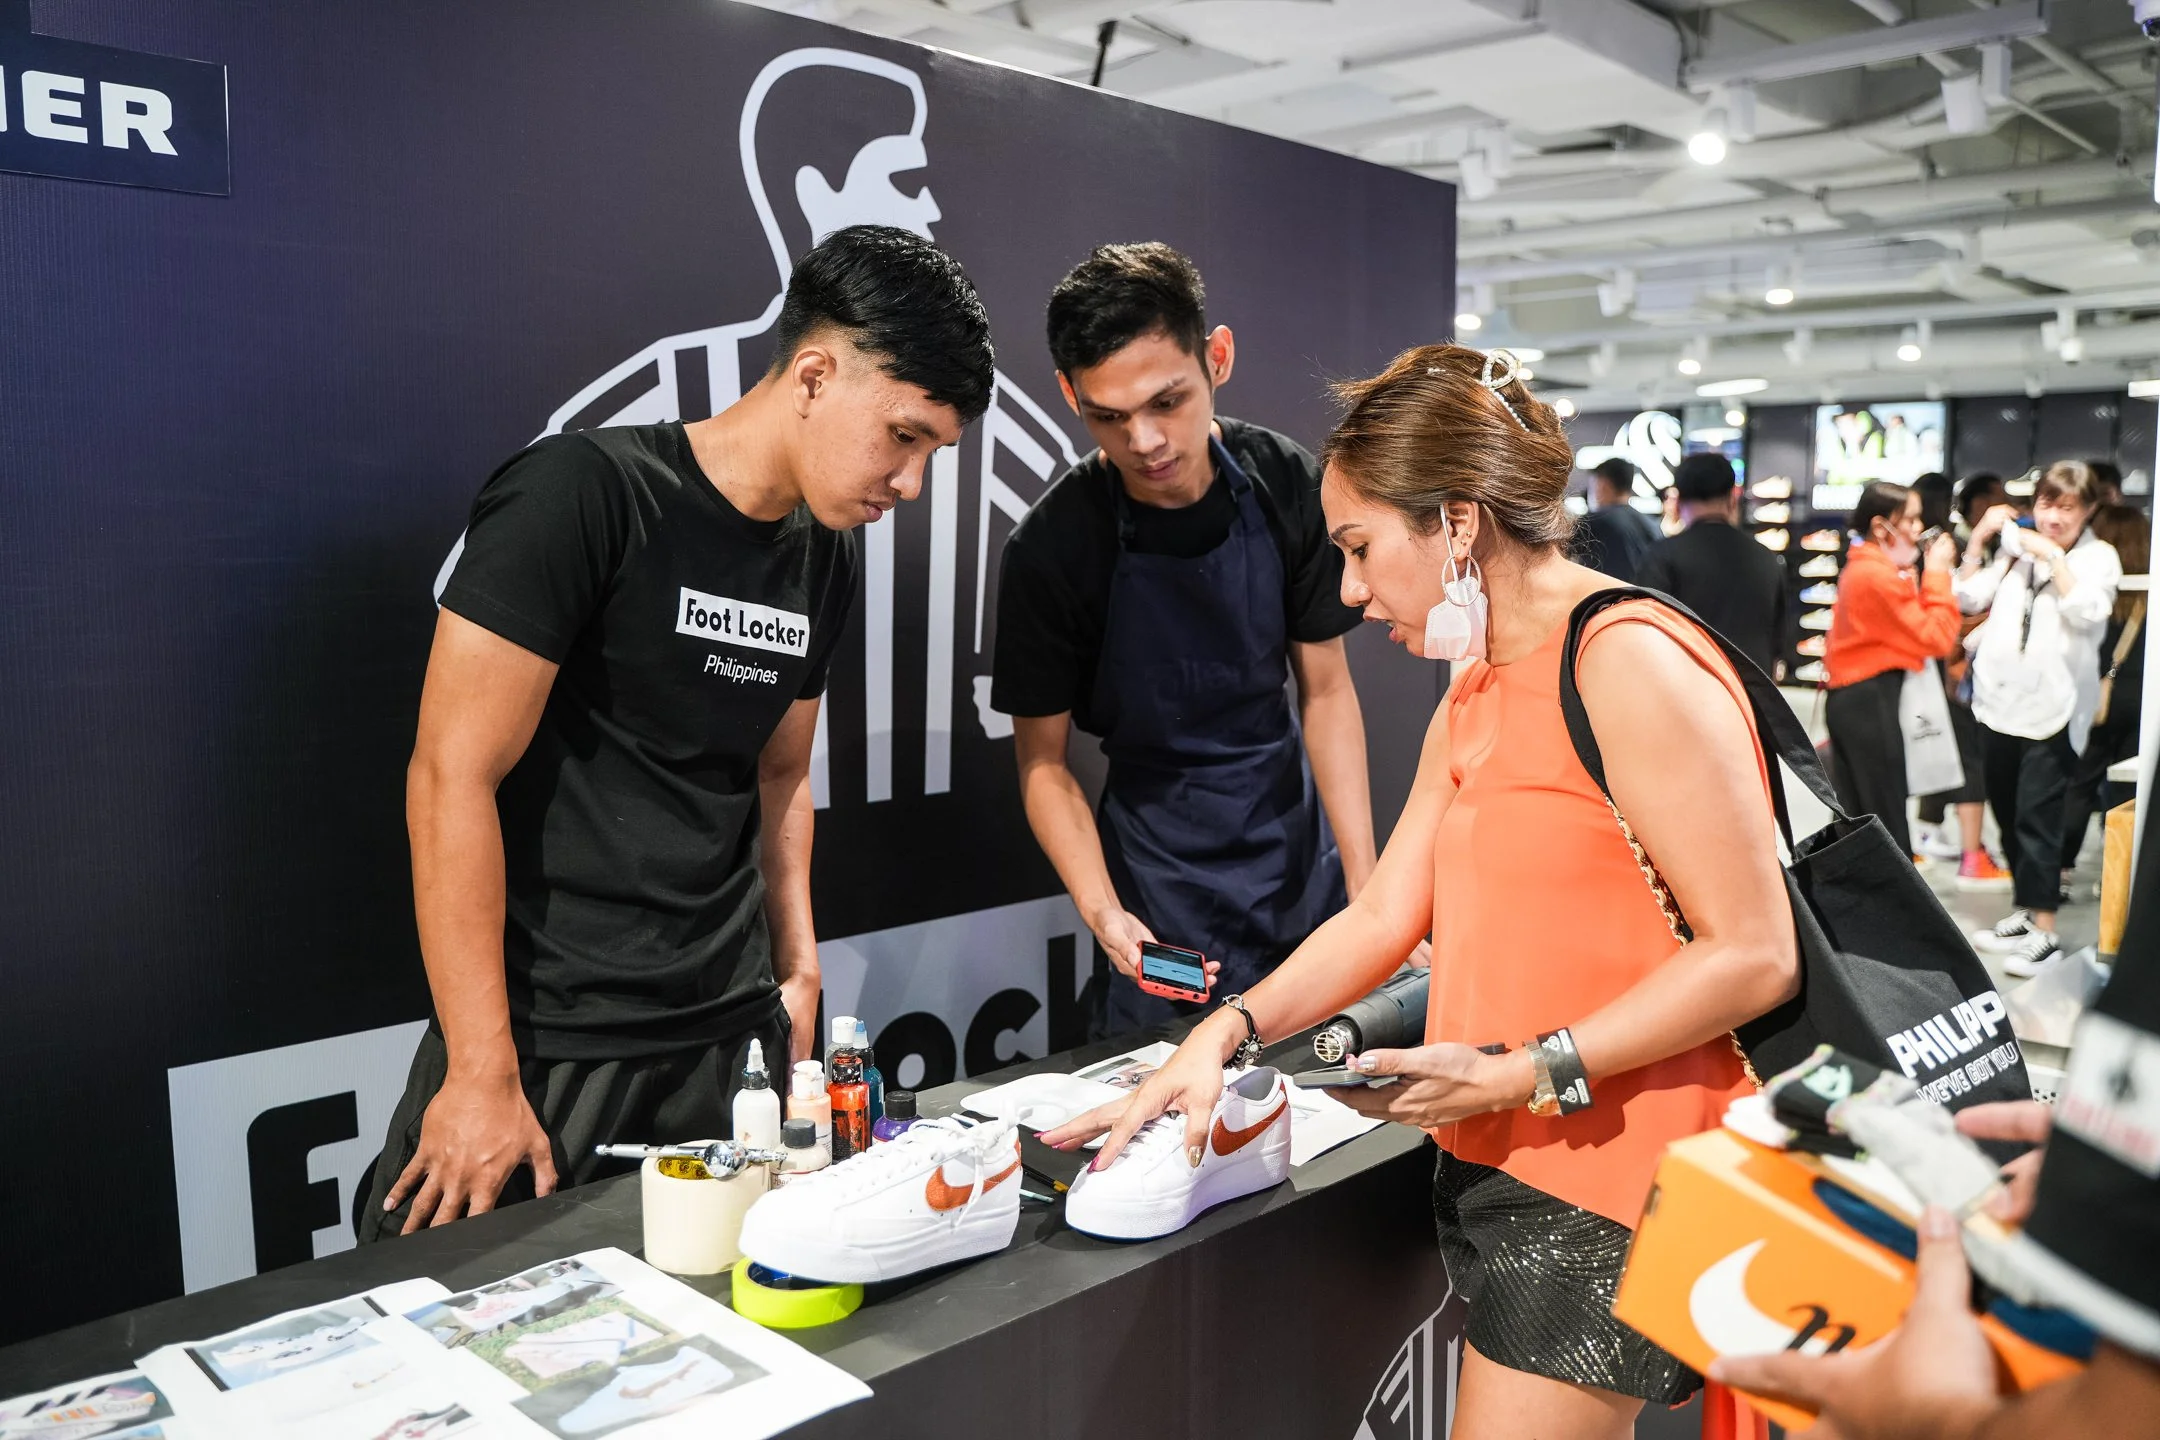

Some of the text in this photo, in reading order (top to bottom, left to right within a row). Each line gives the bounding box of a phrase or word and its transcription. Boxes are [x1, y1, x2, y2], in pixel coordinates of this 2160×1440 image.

[0, 65, 178, 156] ER
[685, 598, 805, 648] Foot Locker
[703, 654, 778, 684] Philippines
[1916, 1067, 1972, 1104] WE'VE
[1965, 1052, 1996, 1087] GOT
